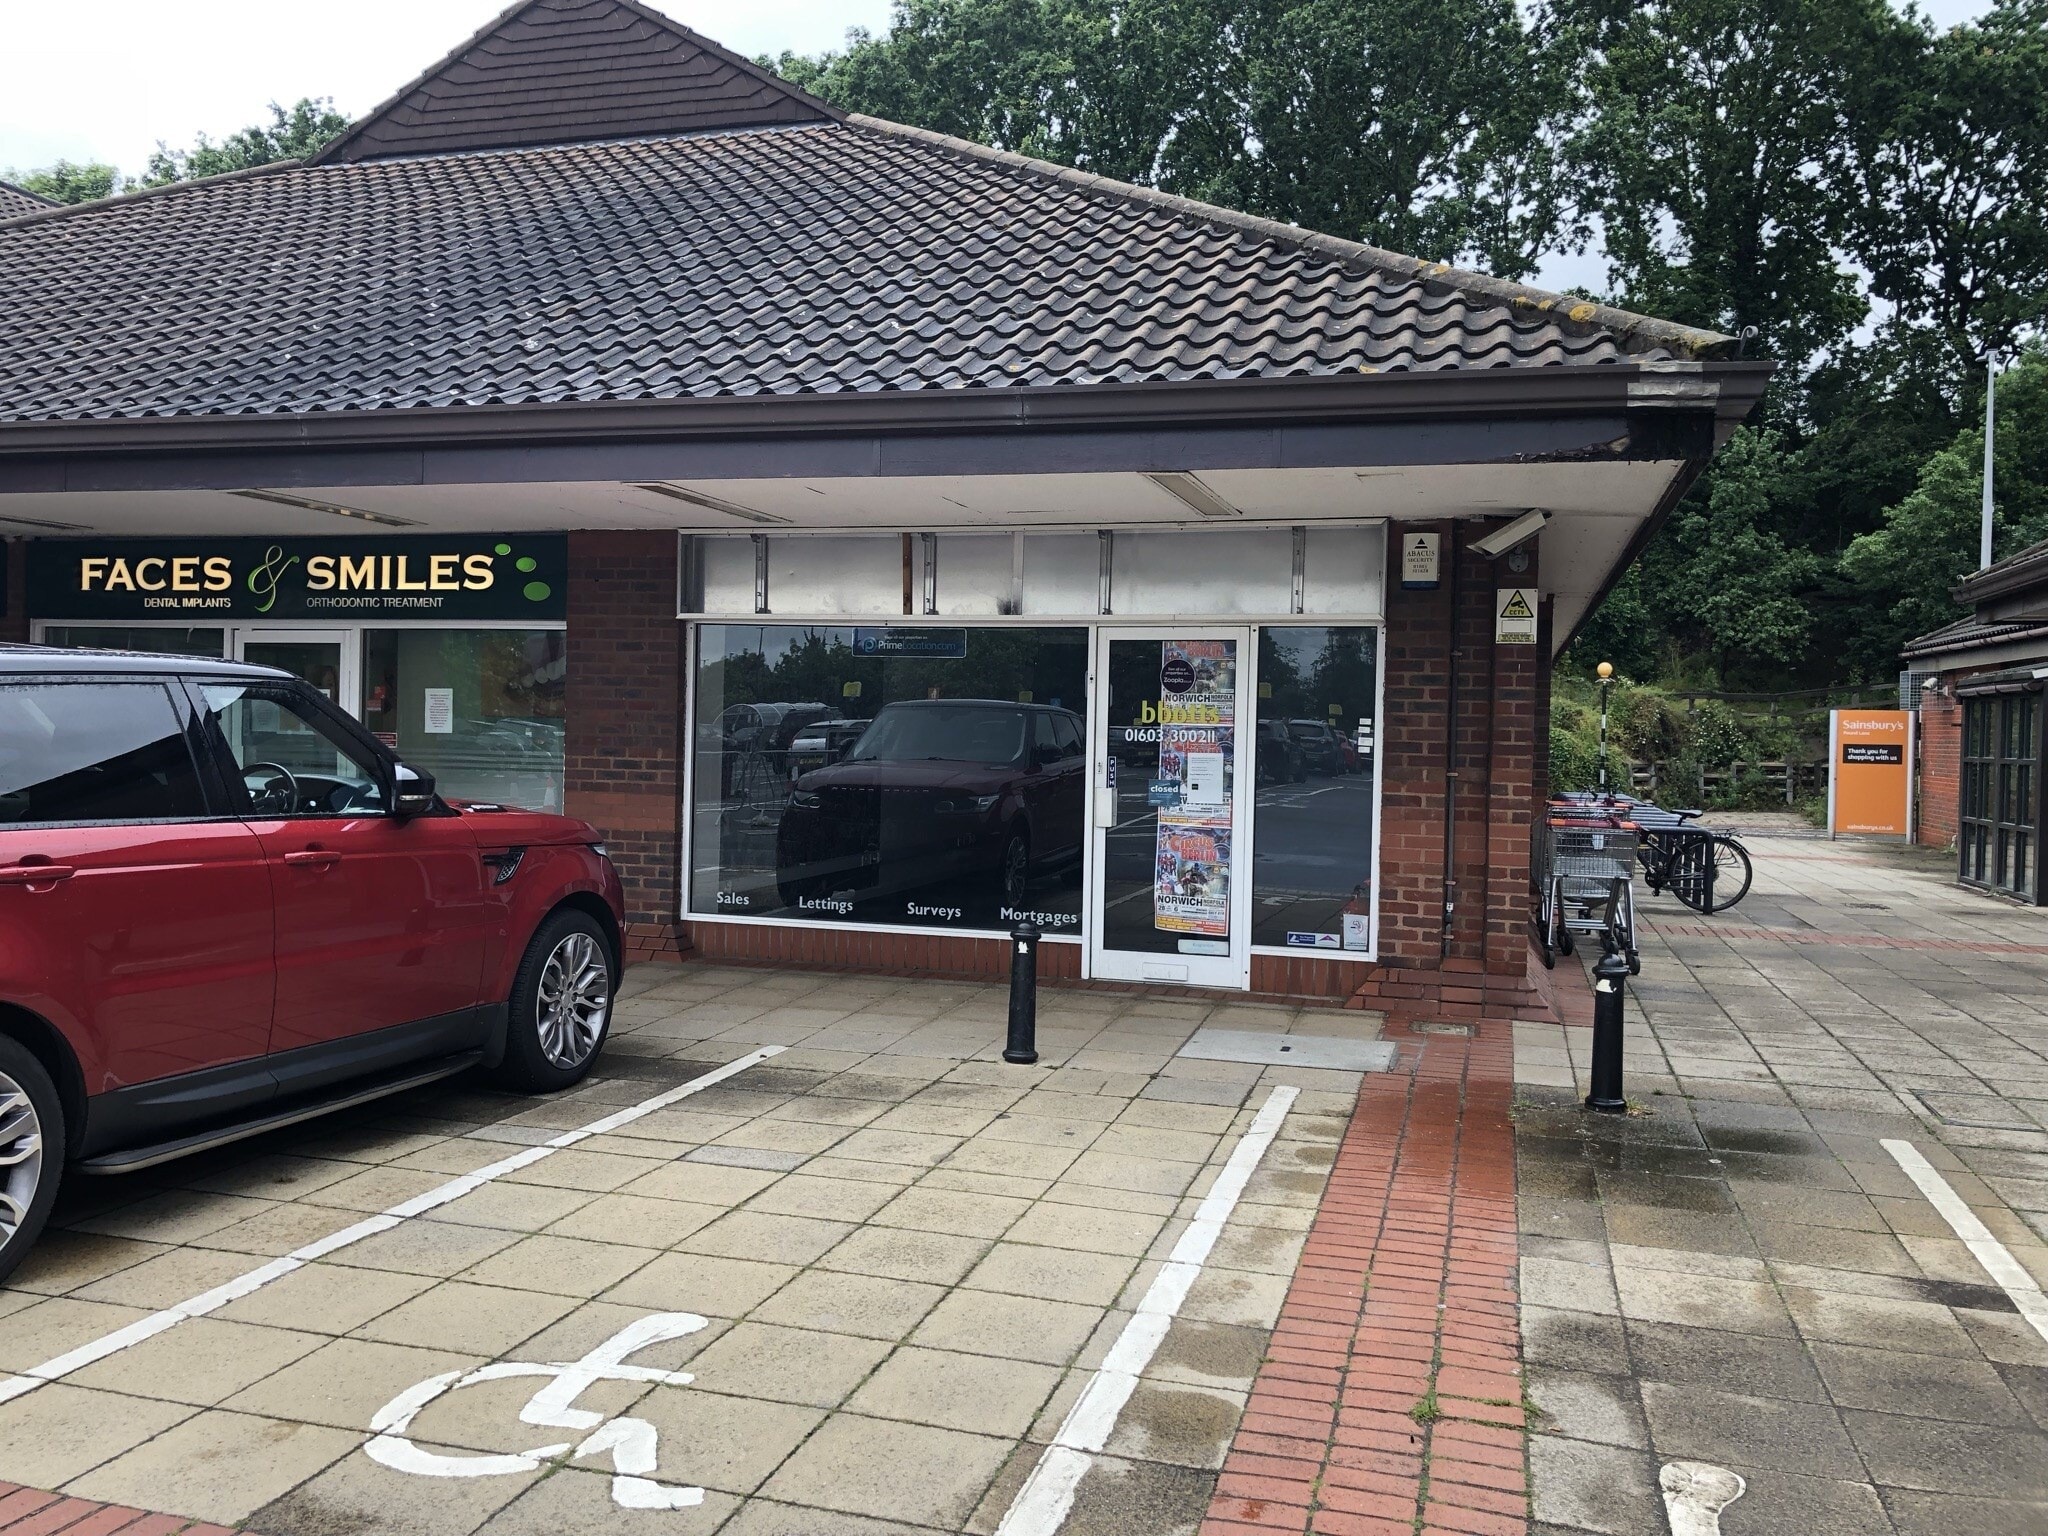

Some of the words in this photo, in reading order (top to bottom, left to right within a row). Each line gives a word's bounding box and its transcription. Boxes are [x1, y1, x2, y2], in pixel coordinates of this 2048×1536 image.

[81, 556, 232, 591] FACES
[248, 545, 300, 612] &
[306, 554, 495, 591] SMILES
[144, 598, 181, 608] DENTAL
[182, 598, 232, 608] IMPLANTS
[306, 598, 380, 608] ORTHODONTIC
[382, 597, 444, 608] TREATMENT
[878, 640, 956, 650] PrimeLocation.com
[1165, 694, 1211, 703] NORWICH
[1842, 720, 1904, 731] Sainsbury's
[1125, 728, 1164, 742] 01603
[1170, 729, 1215, 743] 300211
[1150, 784, 1179, 793] closed
[1181, 848, 1216, 861] BERLIN
[716, 891, 750, 905] Sales
[1157, 895, 1203, 907] NORWICH
[799, 896, 854, 914] Lettings
[906, 902, 962, 920] Surveys
[1000, 906, 1078, 926] Mortgages
